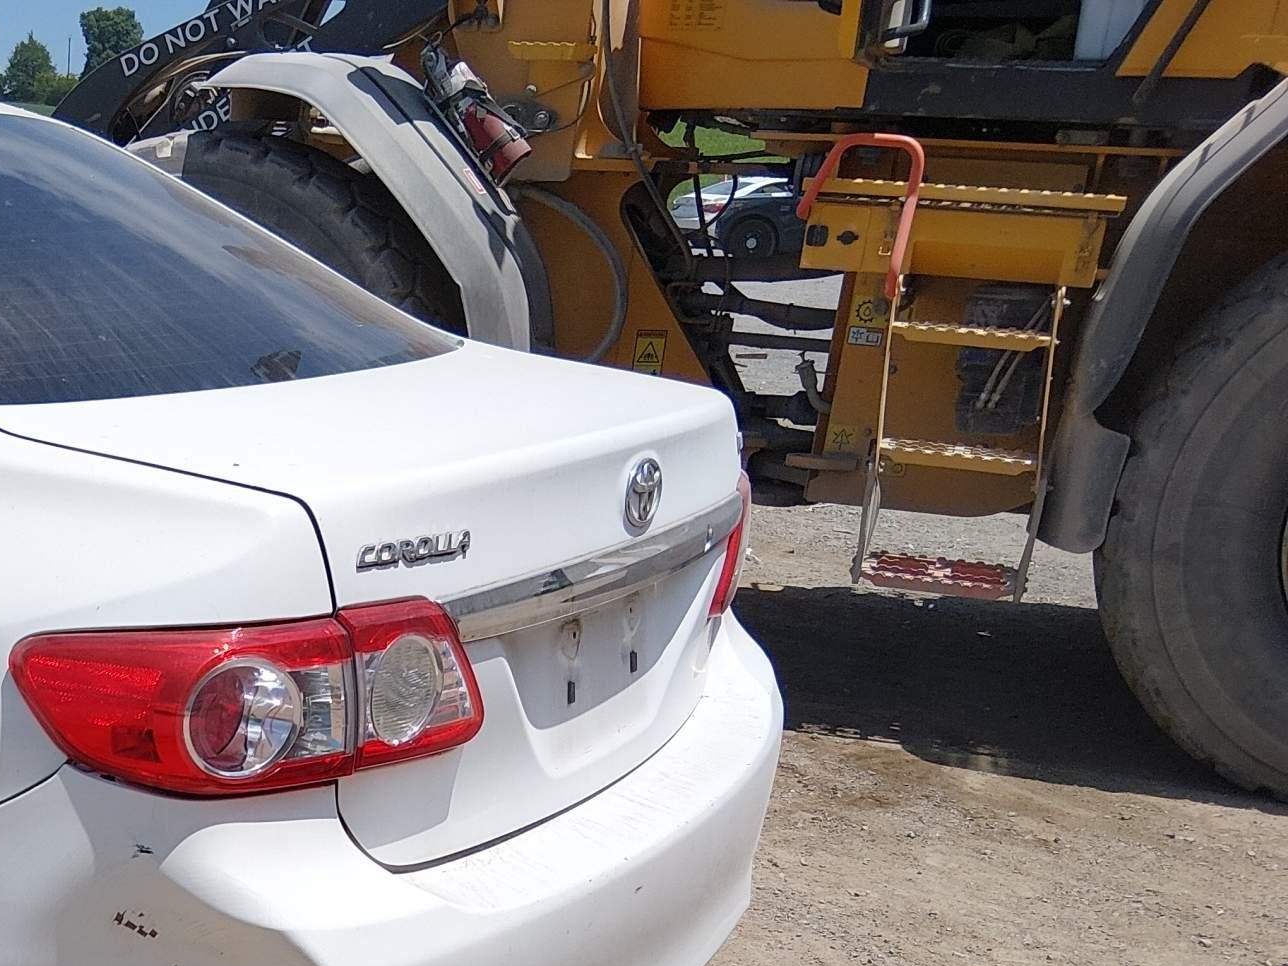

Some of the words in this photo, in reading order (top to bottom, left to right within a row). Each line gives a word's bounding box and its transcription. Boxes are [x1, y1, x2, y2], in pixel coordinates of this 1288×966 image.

[120, 43, 159, 76] DO
[165, 9, 219, 53] NOT
[356, 529, 470, 570] COROLLA
